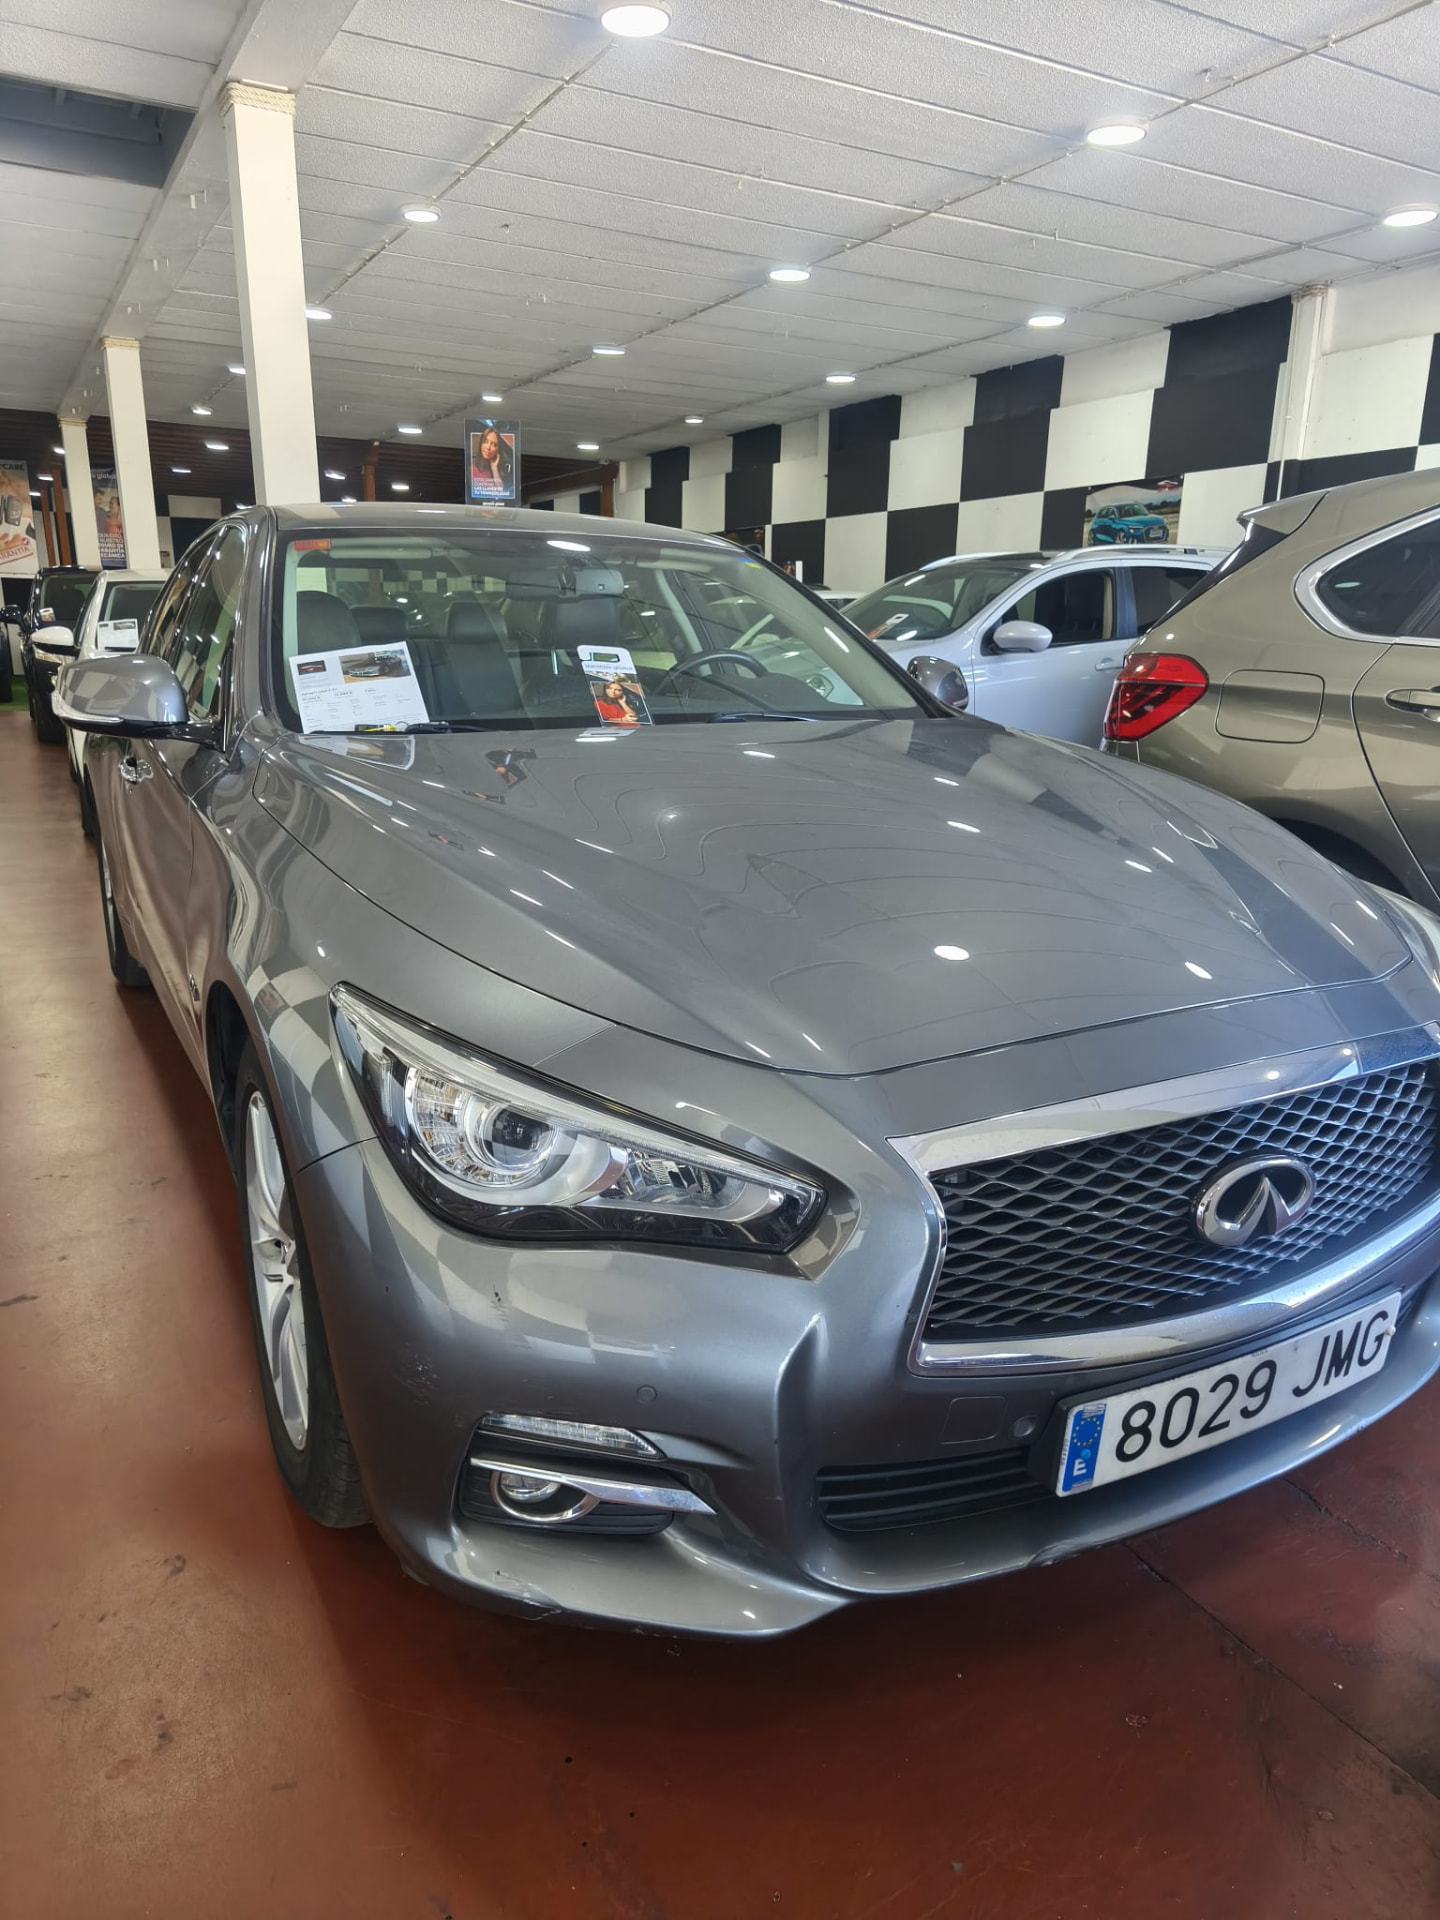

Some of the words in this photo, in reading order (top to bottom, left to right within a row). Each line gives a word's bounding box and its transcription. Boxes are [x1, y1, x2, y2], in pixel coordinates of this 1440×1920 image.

[1073, 1458, 1087, 1476] E
[1115, 1359, 1277, 1463] 8029
[1292, 1310, 1389, 1397] JMG
